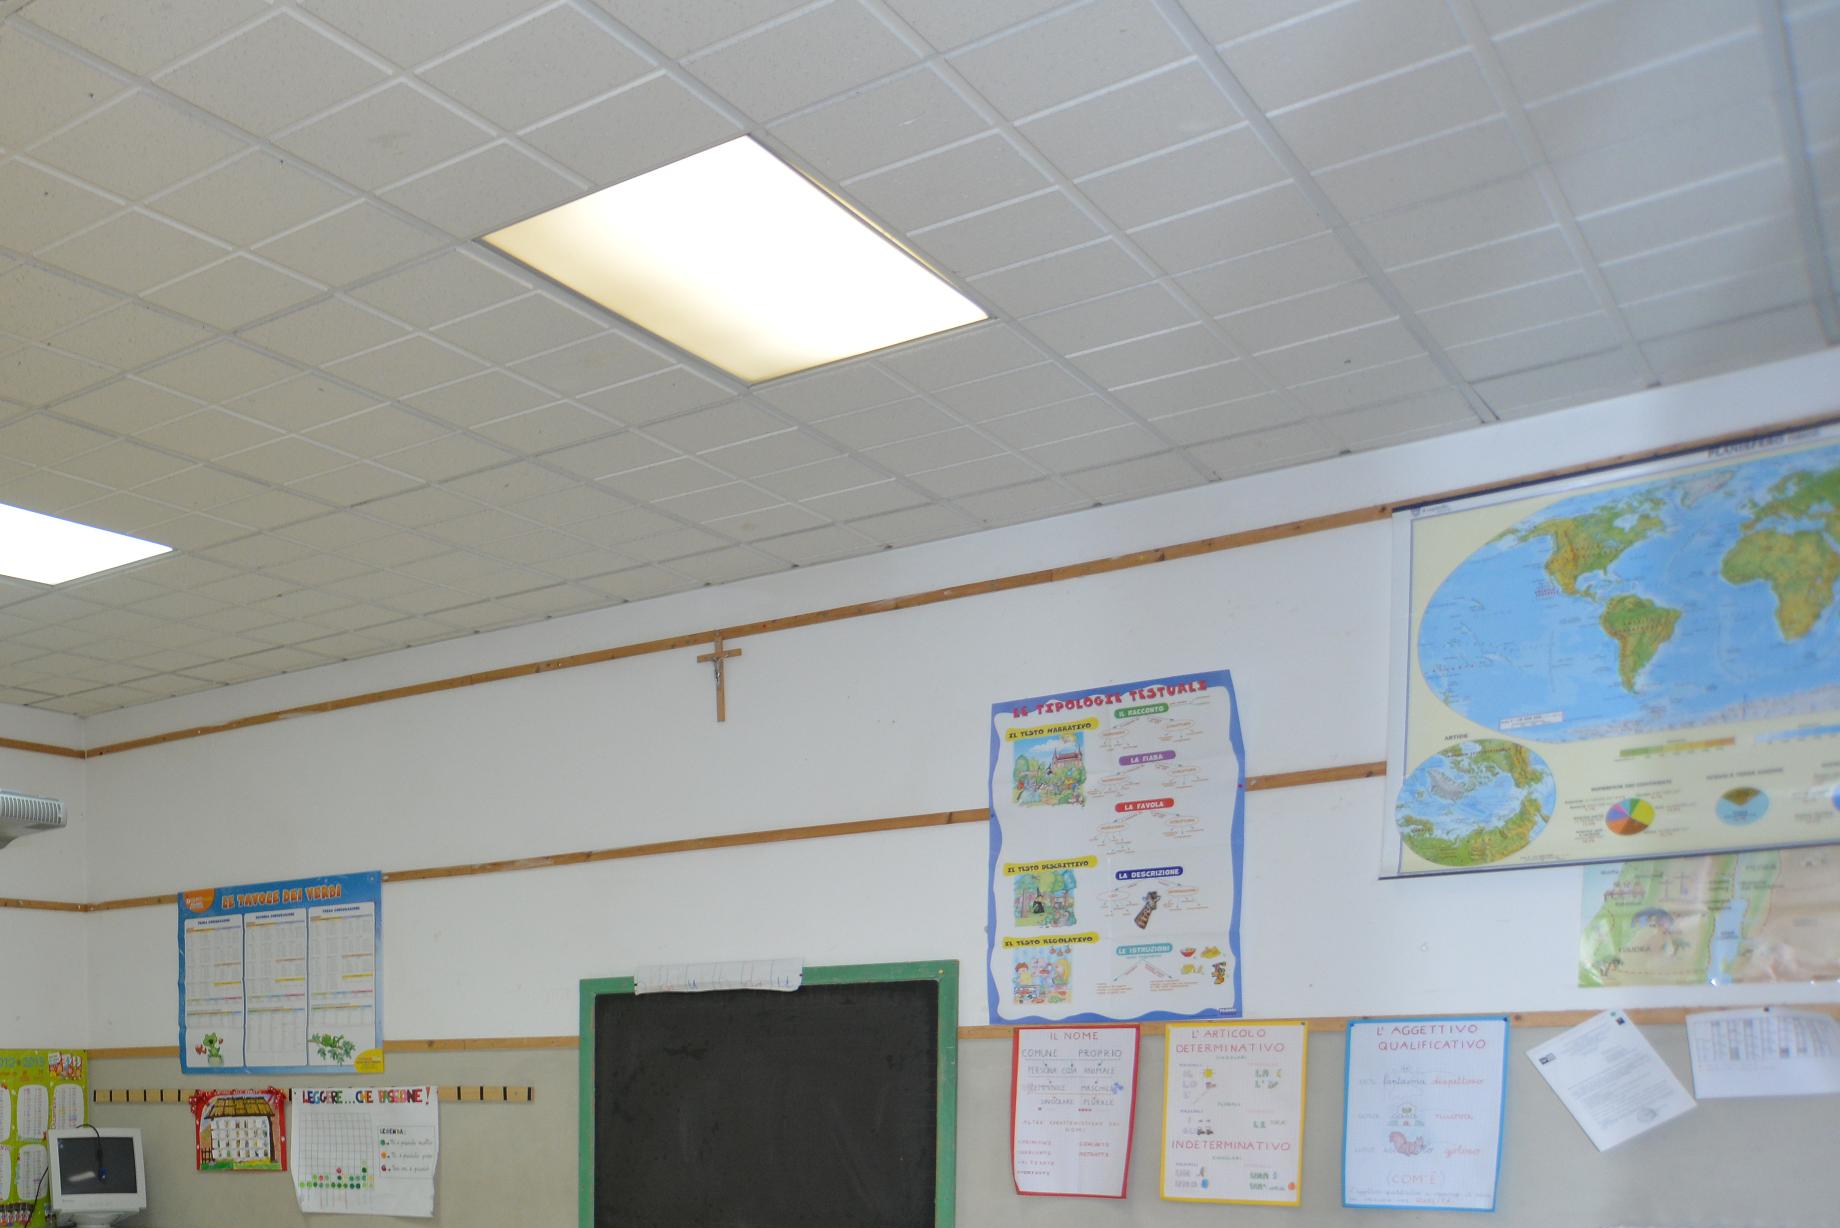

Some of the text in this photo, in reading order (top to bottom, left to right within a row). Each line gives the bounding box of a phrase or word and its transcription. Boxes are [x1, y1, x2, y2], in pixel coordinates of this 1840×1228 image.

[1013, 679, 1208, 718] LE TIPOLOGIE TESTUALI
[1128, 706, 1164, 716] RACCONTO
[1020, 728, 1044, 737] TESTO
[1047, 722, 1092, 735] NARRATIVO
[1136, 801, 1164, 810] FAVOLA
[1018, 864, 1039, 872] TESTO
[1131, 868, 1180, 878] DESCRIZIONE
[221, 895, 235, 909] LE
[237, 889, 279, 909] TAVOLE
[282, 887, 303, 903] DEI
[305, 883, 342, 900] VERBI
[1016, 938, 1040, 946] TESTO
[1204, 1029, 1266, 1039] ARTICOLO
[1392, 1024, 1478, 1036] AGGETTIVO
[1050, 1031, 1099, 1041] IL NOME
[1176, 1043, 1285, 1053] DETERMINATIVO
[1378, 1039, 1486, 1050] QUALIFICATIVO
[1022, 1049, 1122, 1057] COMUNE PROPRIO
[1171, 1140, 1291, 1151] INDETERMINATIVO
